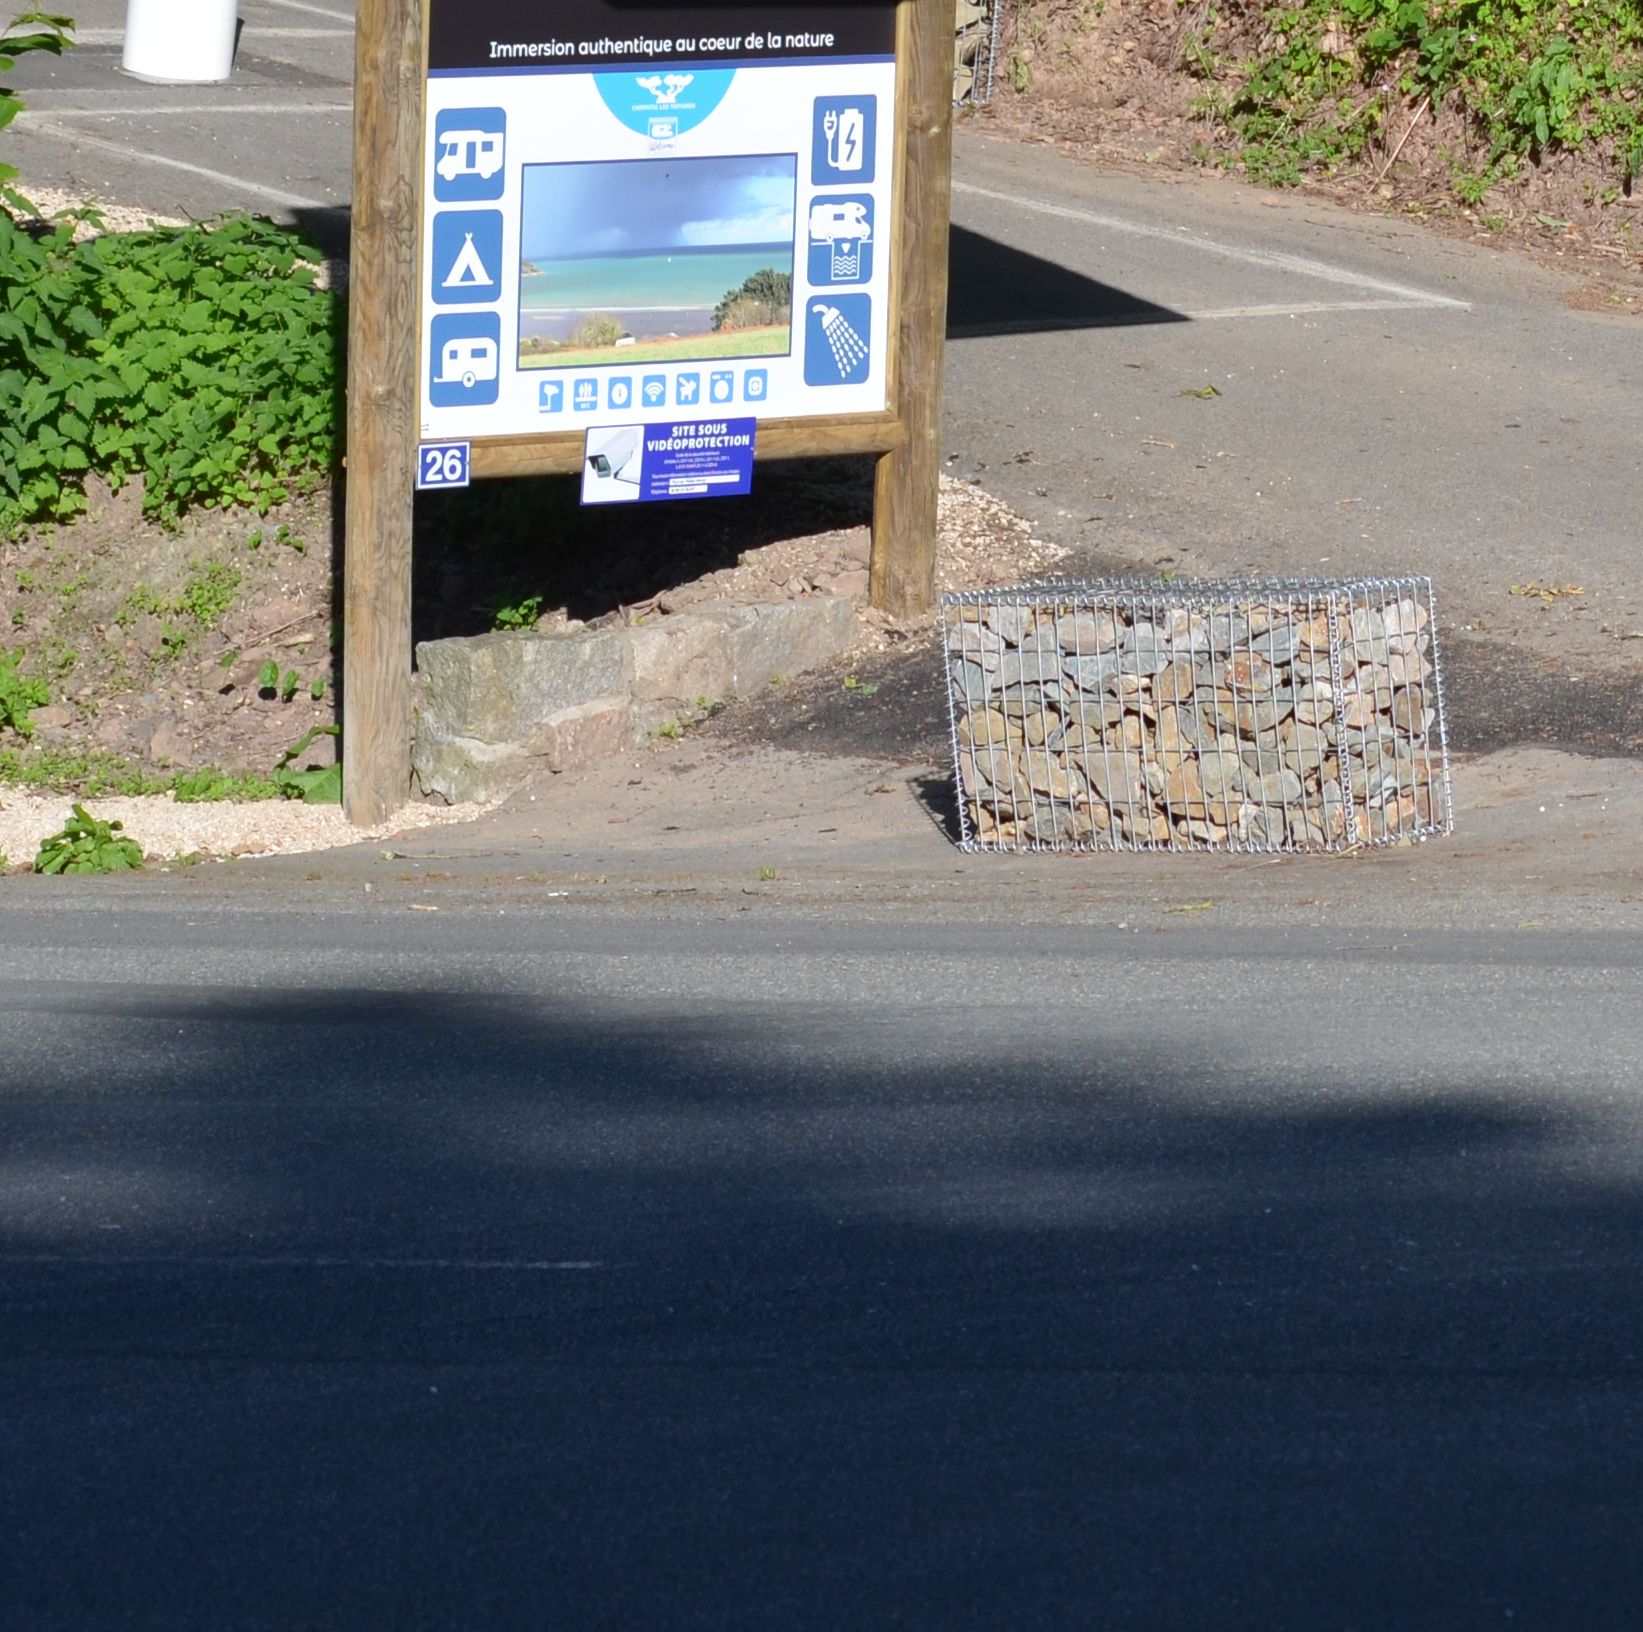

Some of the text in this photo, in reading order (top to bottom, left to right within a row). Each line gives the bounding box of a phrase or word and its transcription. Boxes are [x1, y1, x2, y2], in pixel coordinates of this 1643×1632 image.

[490, 32, 834, 57] Immersion authentique au coeur de la nature
[672, 423, 727, 437] SITE SOUS
[648, 435, 749, 451] VIDÉOPROTECTION
[425, 450, 462, 481] 26
